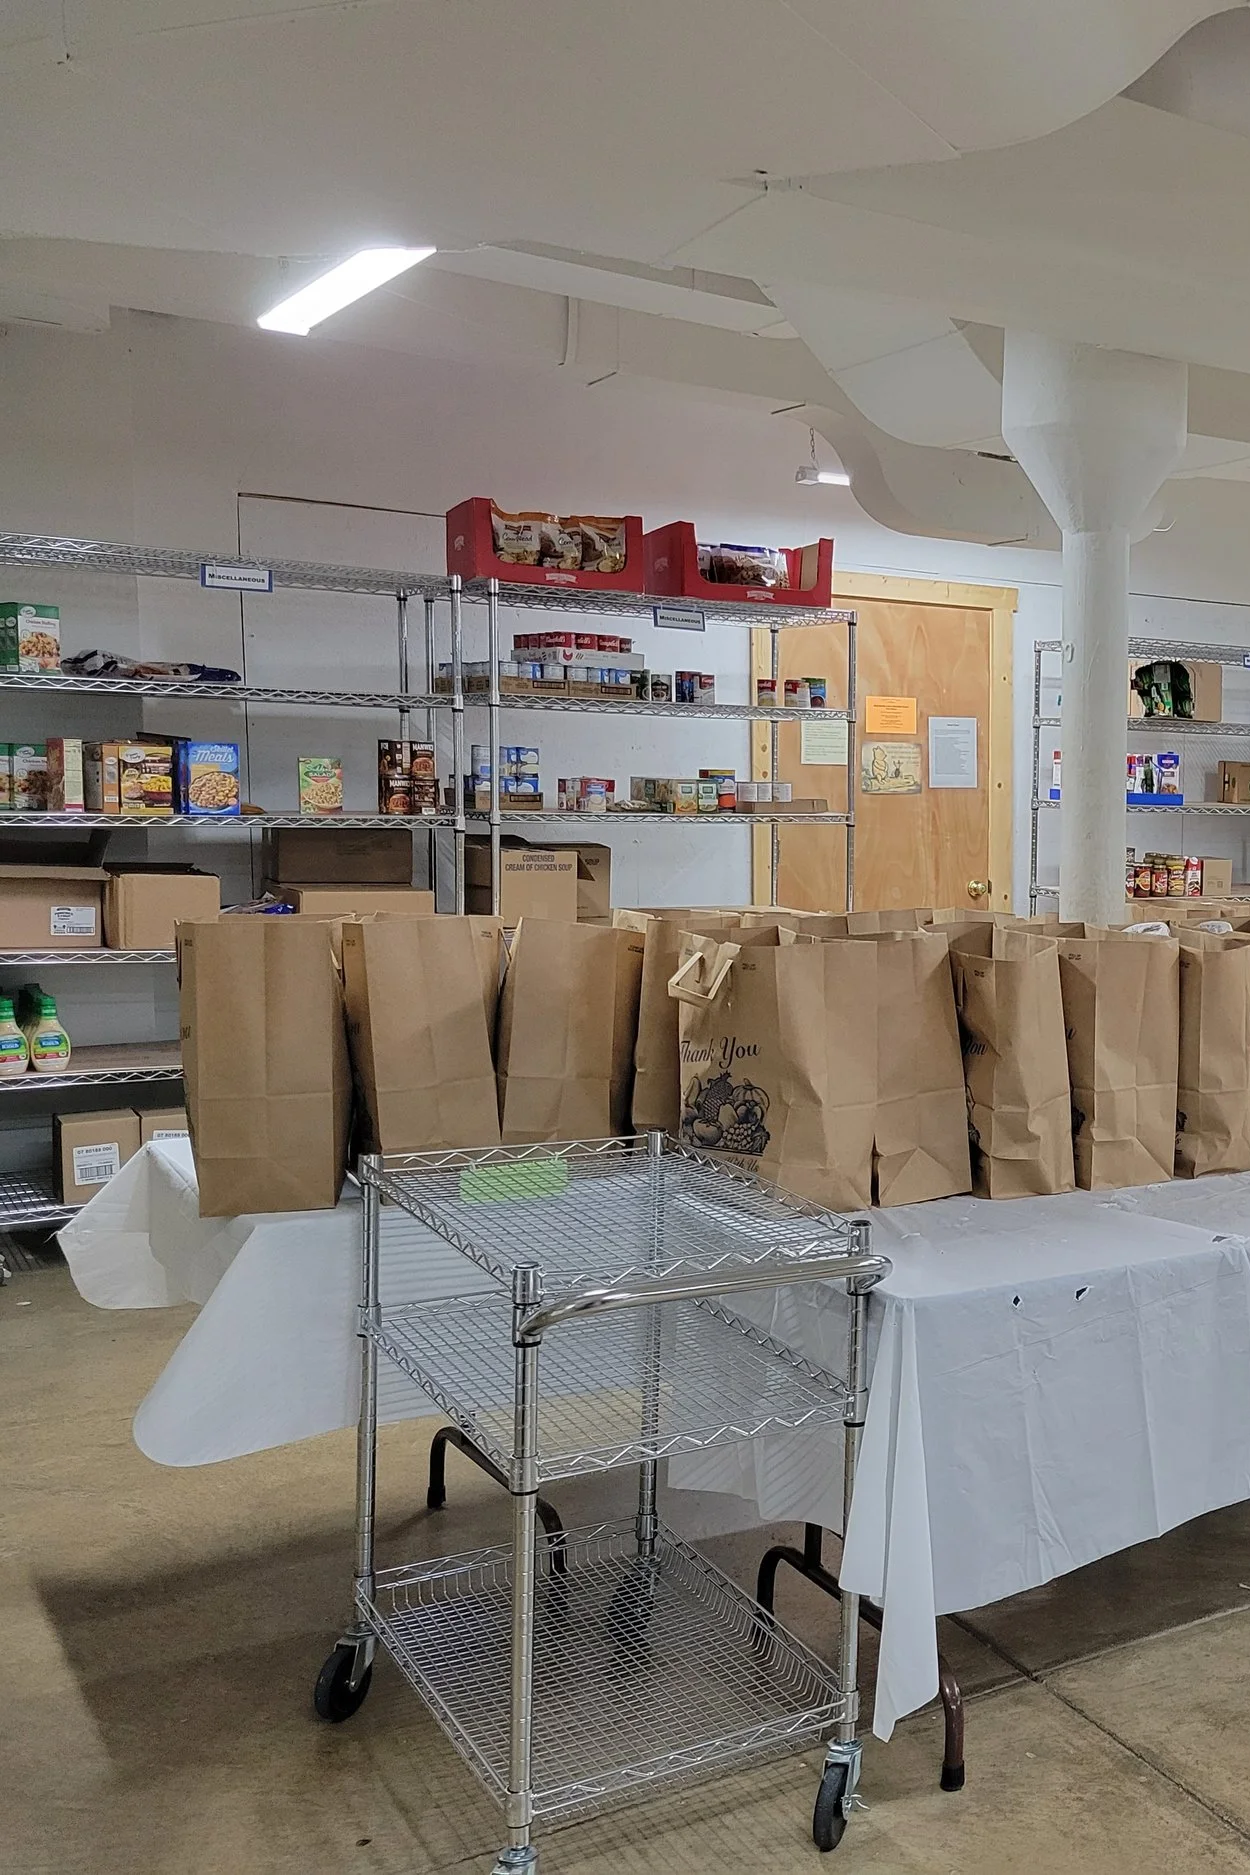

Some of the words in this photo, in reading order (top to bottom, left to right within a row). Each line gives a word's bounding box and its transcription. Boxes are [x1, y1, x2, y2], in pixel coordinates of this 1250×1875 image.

[659, 615, 701, 625] MISCELLANEOUS
[195, 750, 233, 763] Meals
[522, 854, 555, 863] CONDENSED
[505, 863, 525, 872] CREAM
[526, 863, 533, 872] OF
[534, 864, 558, 872] CHICKEN
[558, 863, 573, 872] SOUP
[719, 1036, 760, 1070] You
